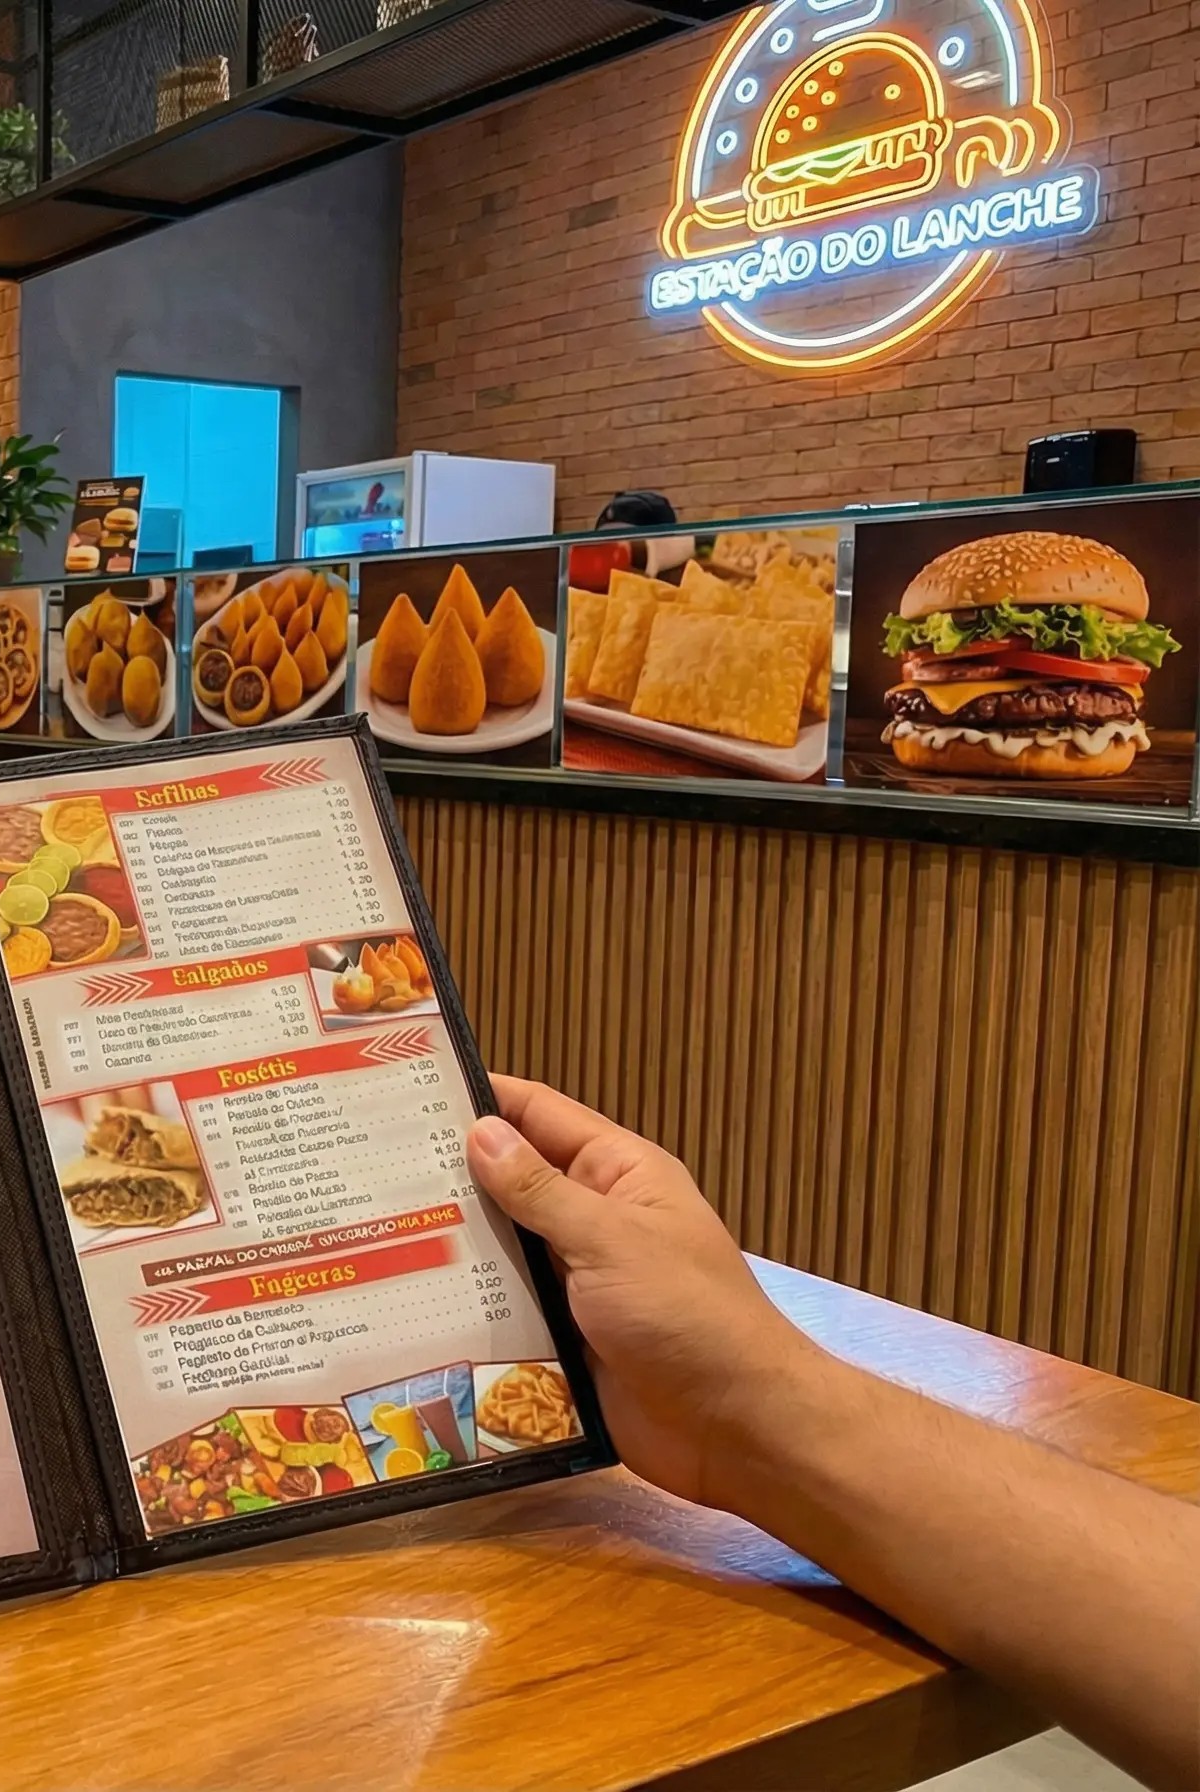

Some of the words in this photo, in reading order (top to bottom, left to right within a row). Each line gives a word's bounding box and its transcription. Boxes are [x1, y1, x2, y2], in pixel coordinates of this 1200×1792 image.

[650, 236, 817, 308] ESTAÇÃO
[819, 224, 887, 274] DO
[892, 175, 1084, 258] LANCHE
[236, 1249, 258, 1262] DO
